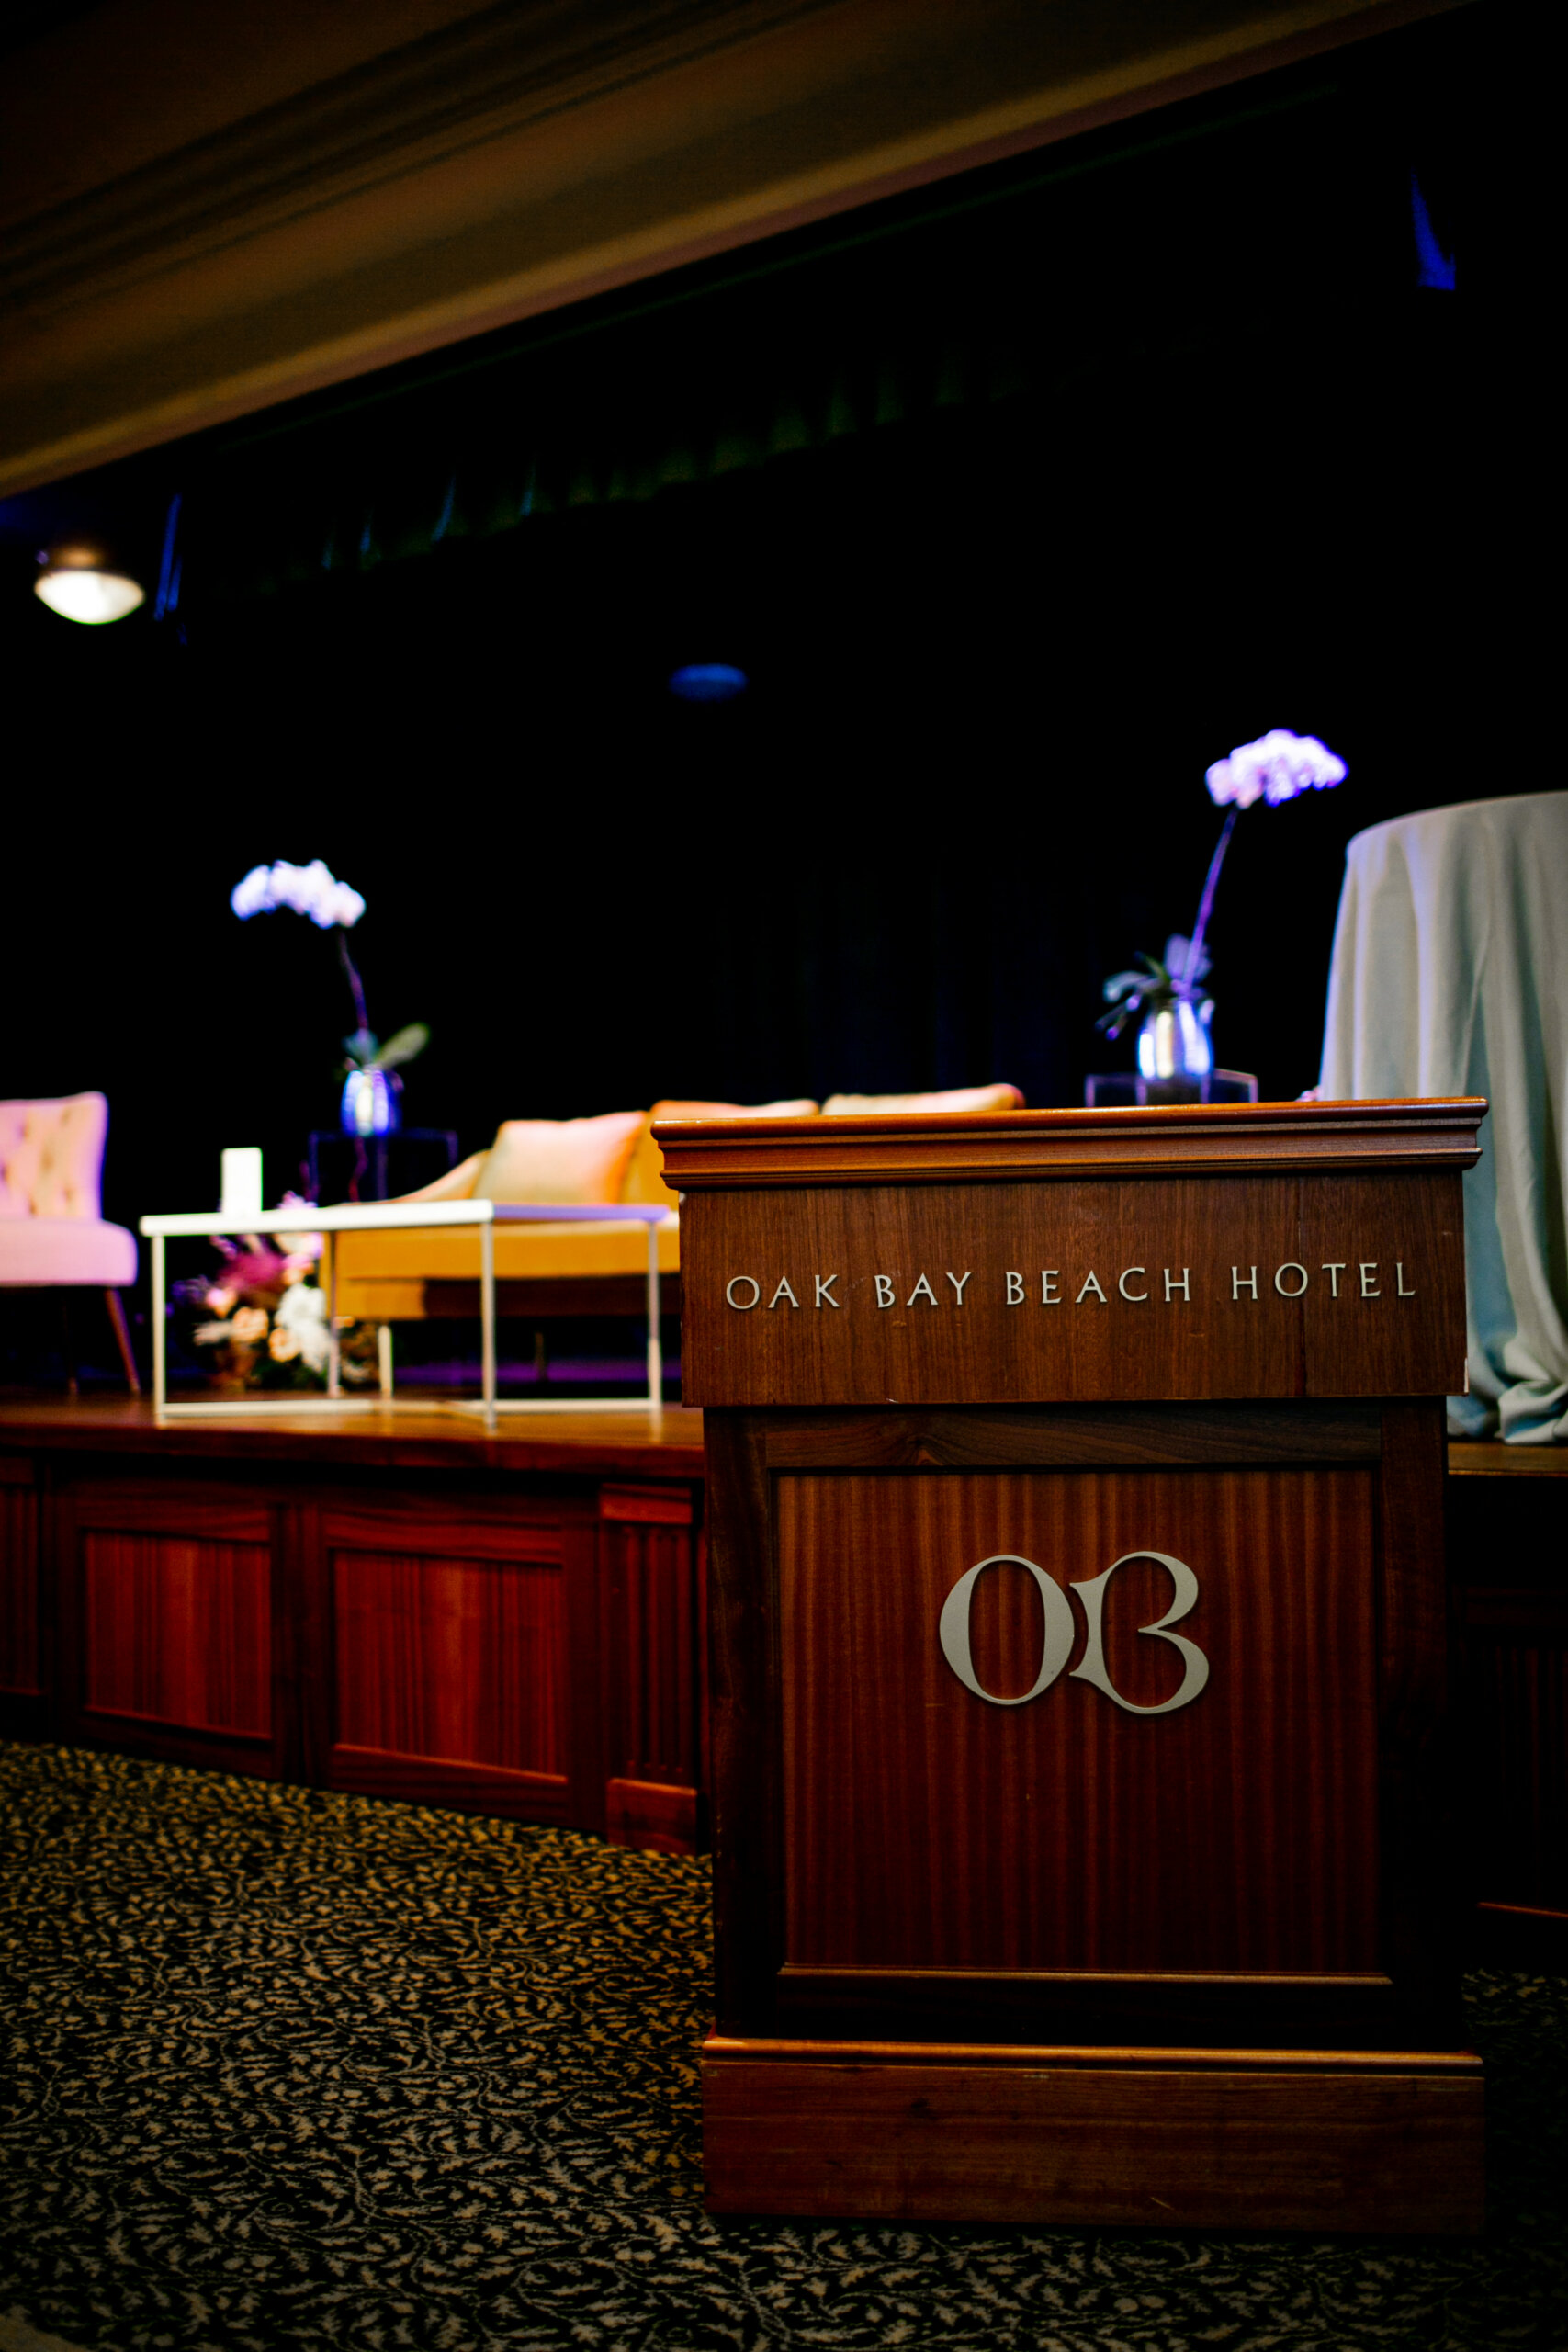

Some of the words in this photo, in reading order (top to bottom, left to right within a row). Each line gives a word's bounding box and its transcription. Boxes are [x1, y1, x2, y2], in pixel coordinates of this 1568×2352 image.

[726, 1275, 840, 1309] OAK
[874, 1272, 972, 1308] BAY
[1005, 1267, 1190, 1305] BEACH
[1231, 1262, 1416, 1300] HOTEL
[939, 1550, 1210, 1714] OB
